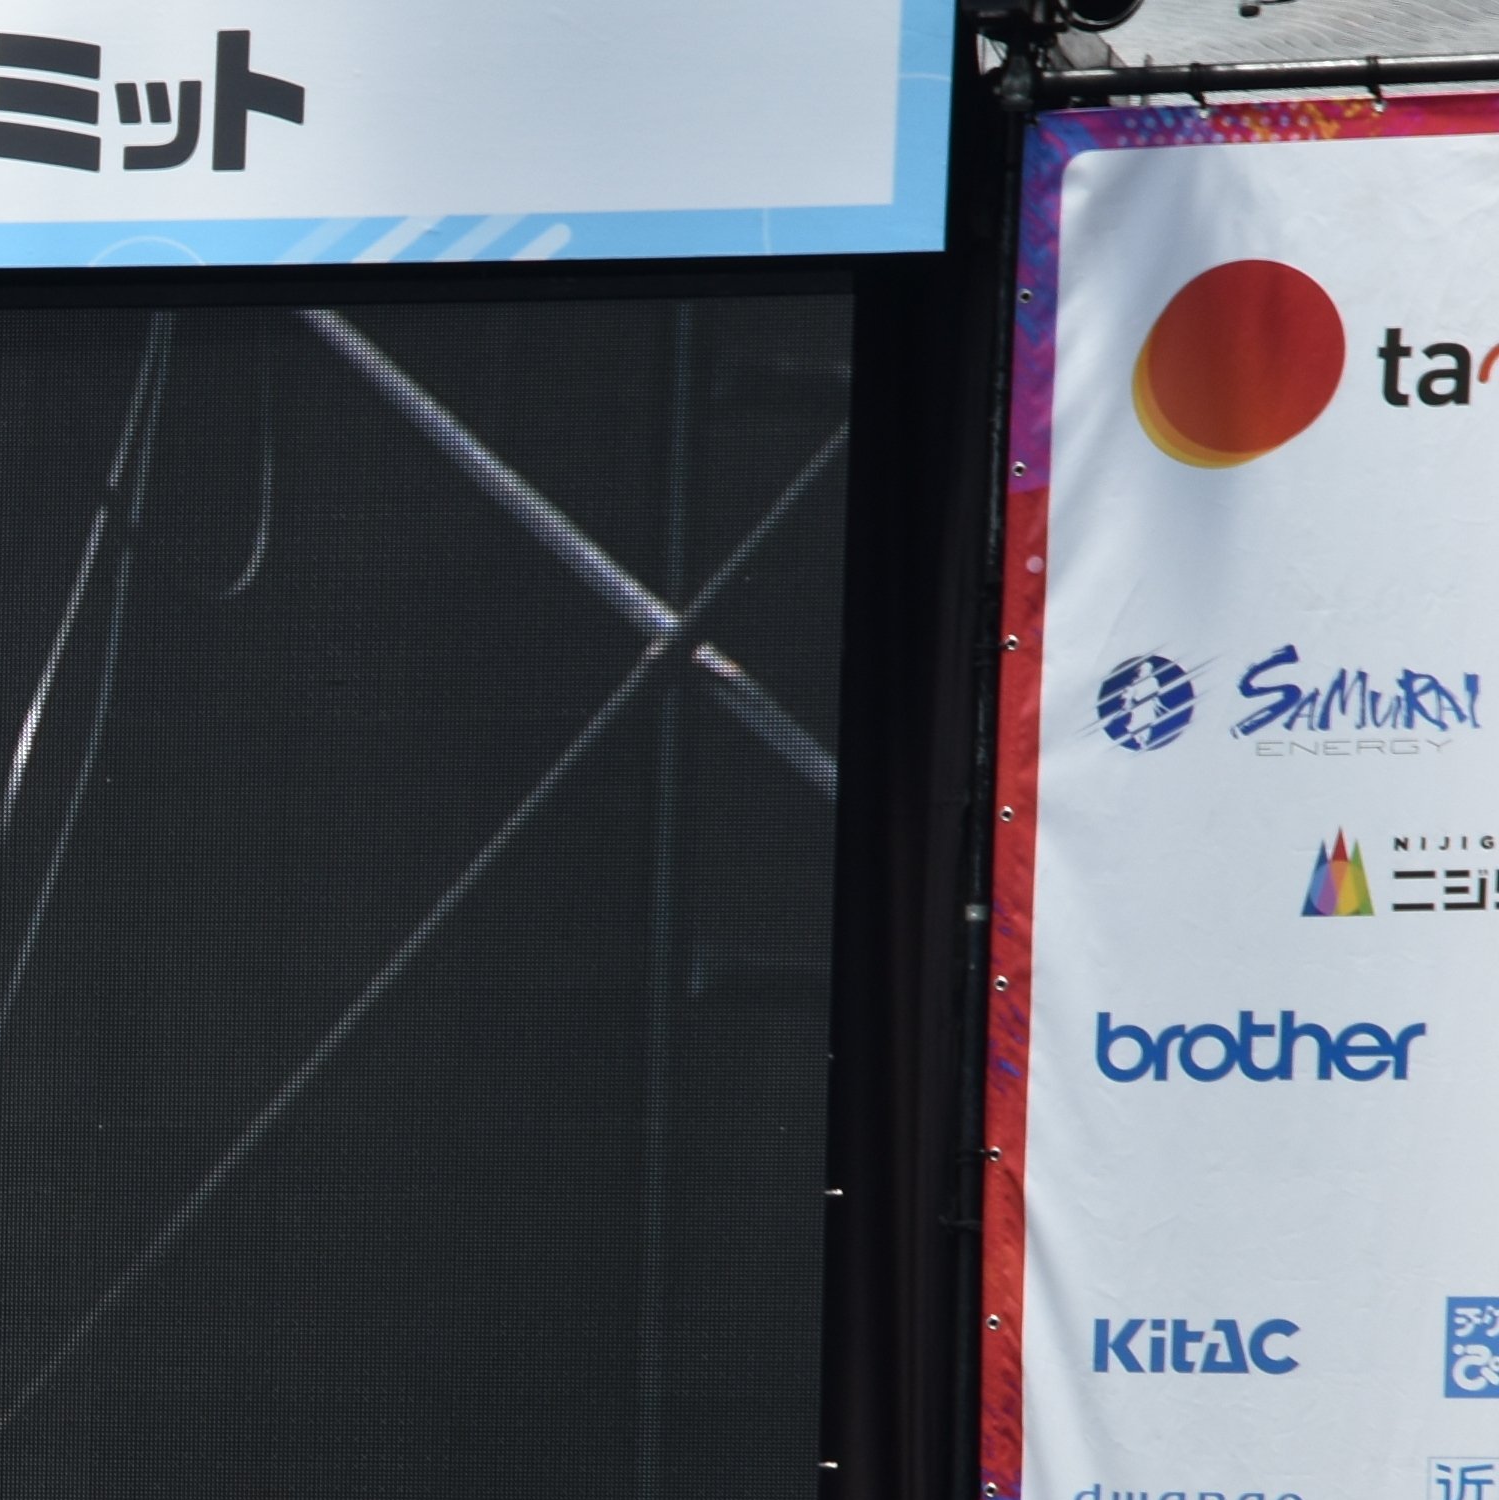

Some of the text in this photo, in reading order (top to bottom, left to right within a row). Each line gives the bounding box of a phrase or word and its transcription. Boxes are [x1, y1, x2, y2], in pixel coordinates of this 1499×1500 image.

[1376, 328, 1499, 409] ta
[1255, 738, 1453, 757] ENERGY
[1393, 869, 1499, 912] ニジ
[1095, 1010, 1426, 1083] brother
